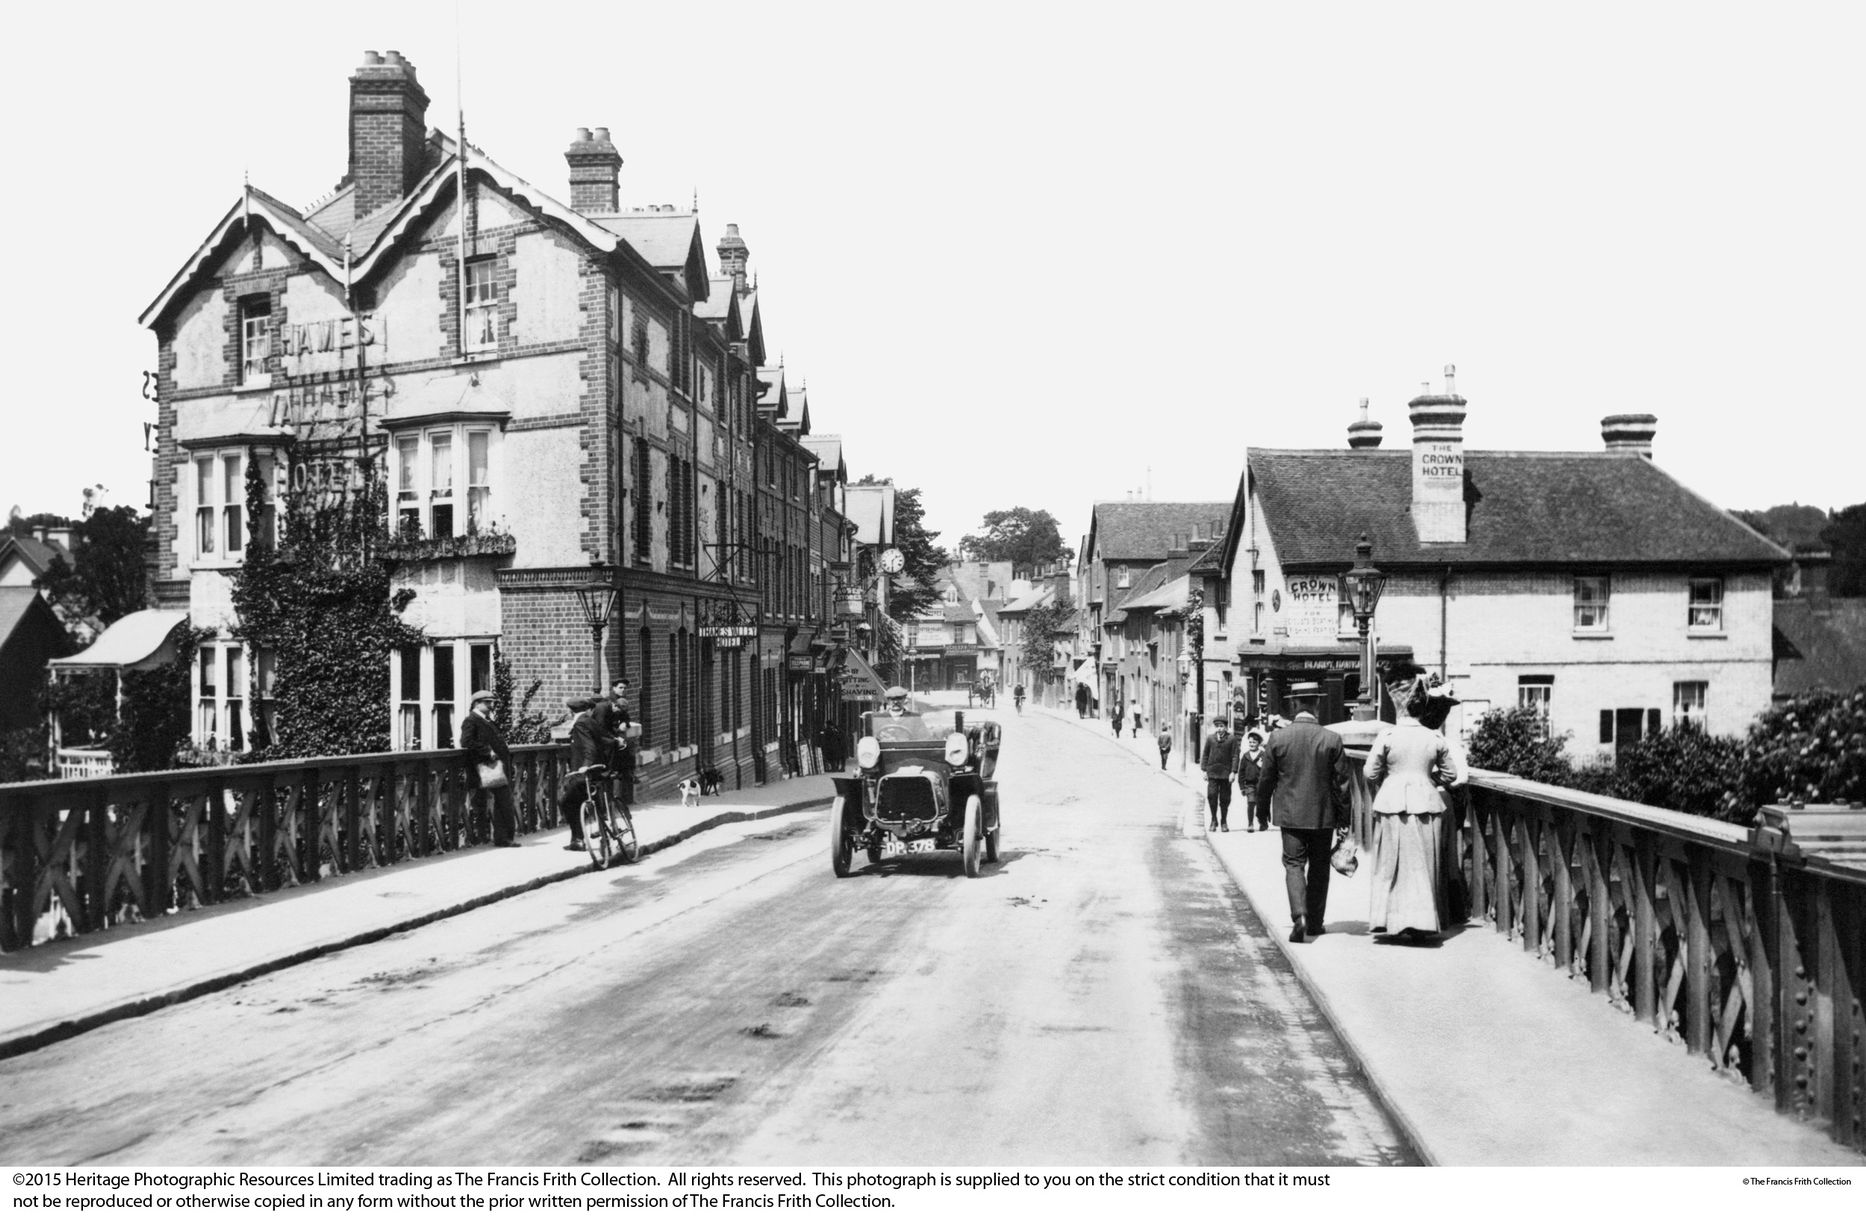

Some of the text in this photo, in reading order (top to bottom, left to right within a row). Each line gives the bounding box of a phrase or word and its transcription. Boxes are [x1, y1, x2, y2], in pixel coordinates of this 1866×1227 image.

[1432, 444, 1452, 452] THE
[1422, 453, 1462, 464] CROWN
[1422, 465, 1463, 476] HOTEL
[1291, 579, 1336, 593] CROWN
[1293, 592, 1332, 601] HOTEL
[840, 688, 877, 696] SHAVING
